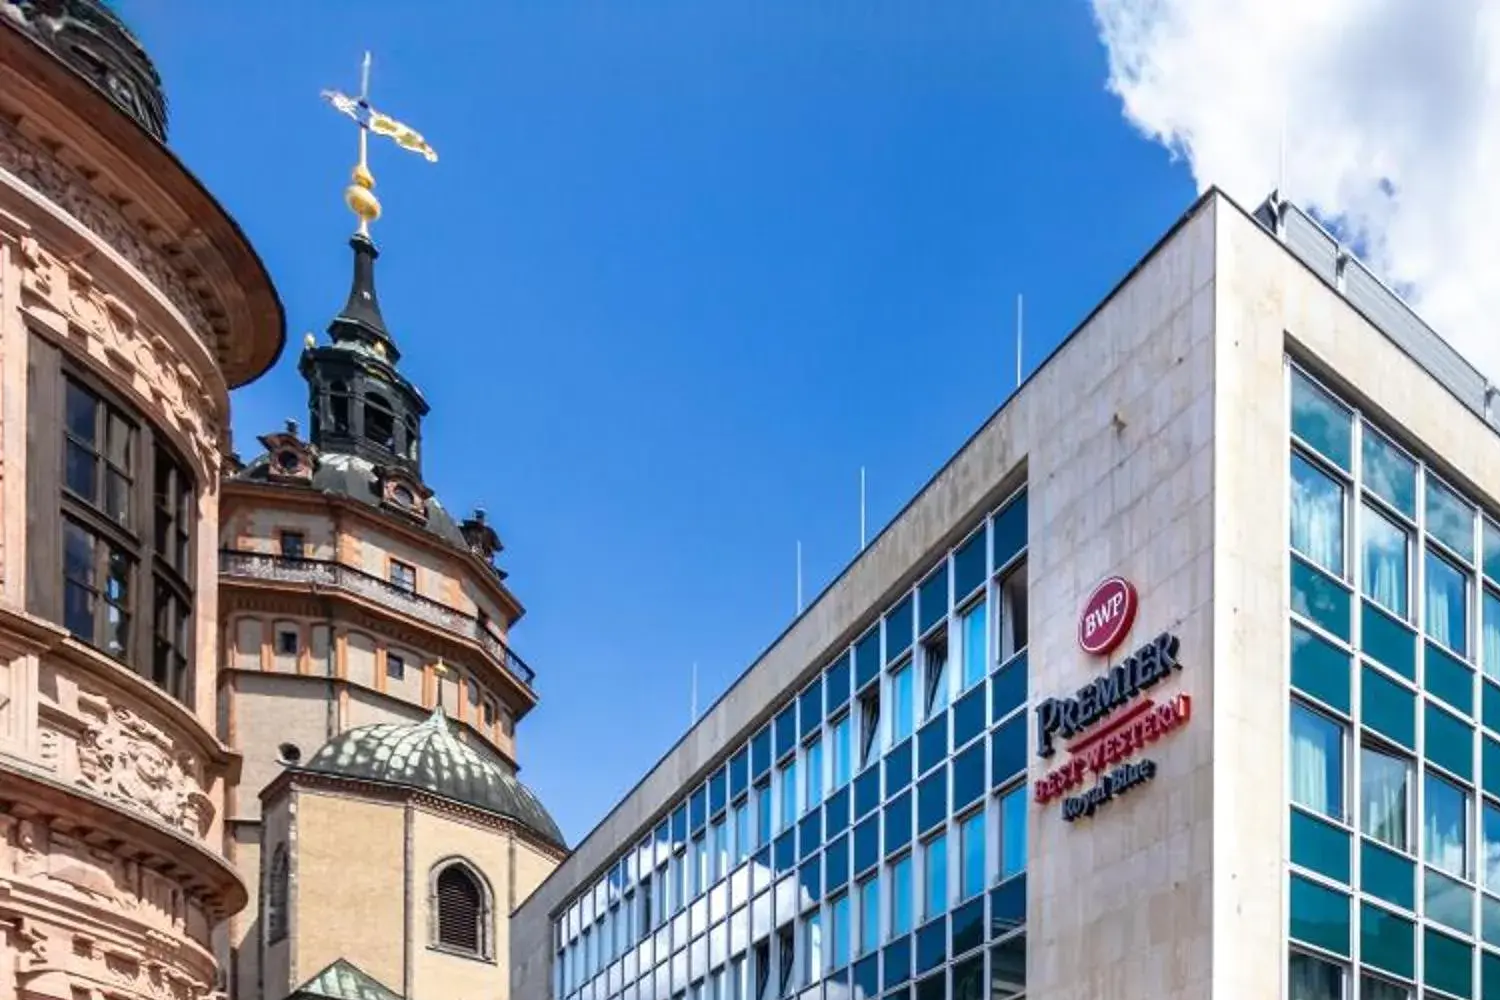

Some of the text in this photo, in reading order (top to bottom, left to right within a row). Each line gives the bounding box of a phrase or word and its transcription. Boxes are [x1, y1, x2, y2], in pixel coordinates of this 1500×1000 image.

[1084, 591, 1123, 638] BWP
[1036, 632, 1182, 757] PREMIER
[1034, 693, 1192, 804] BEST WESTERN
[1061, 759, 1157, 821] Royal Blue
